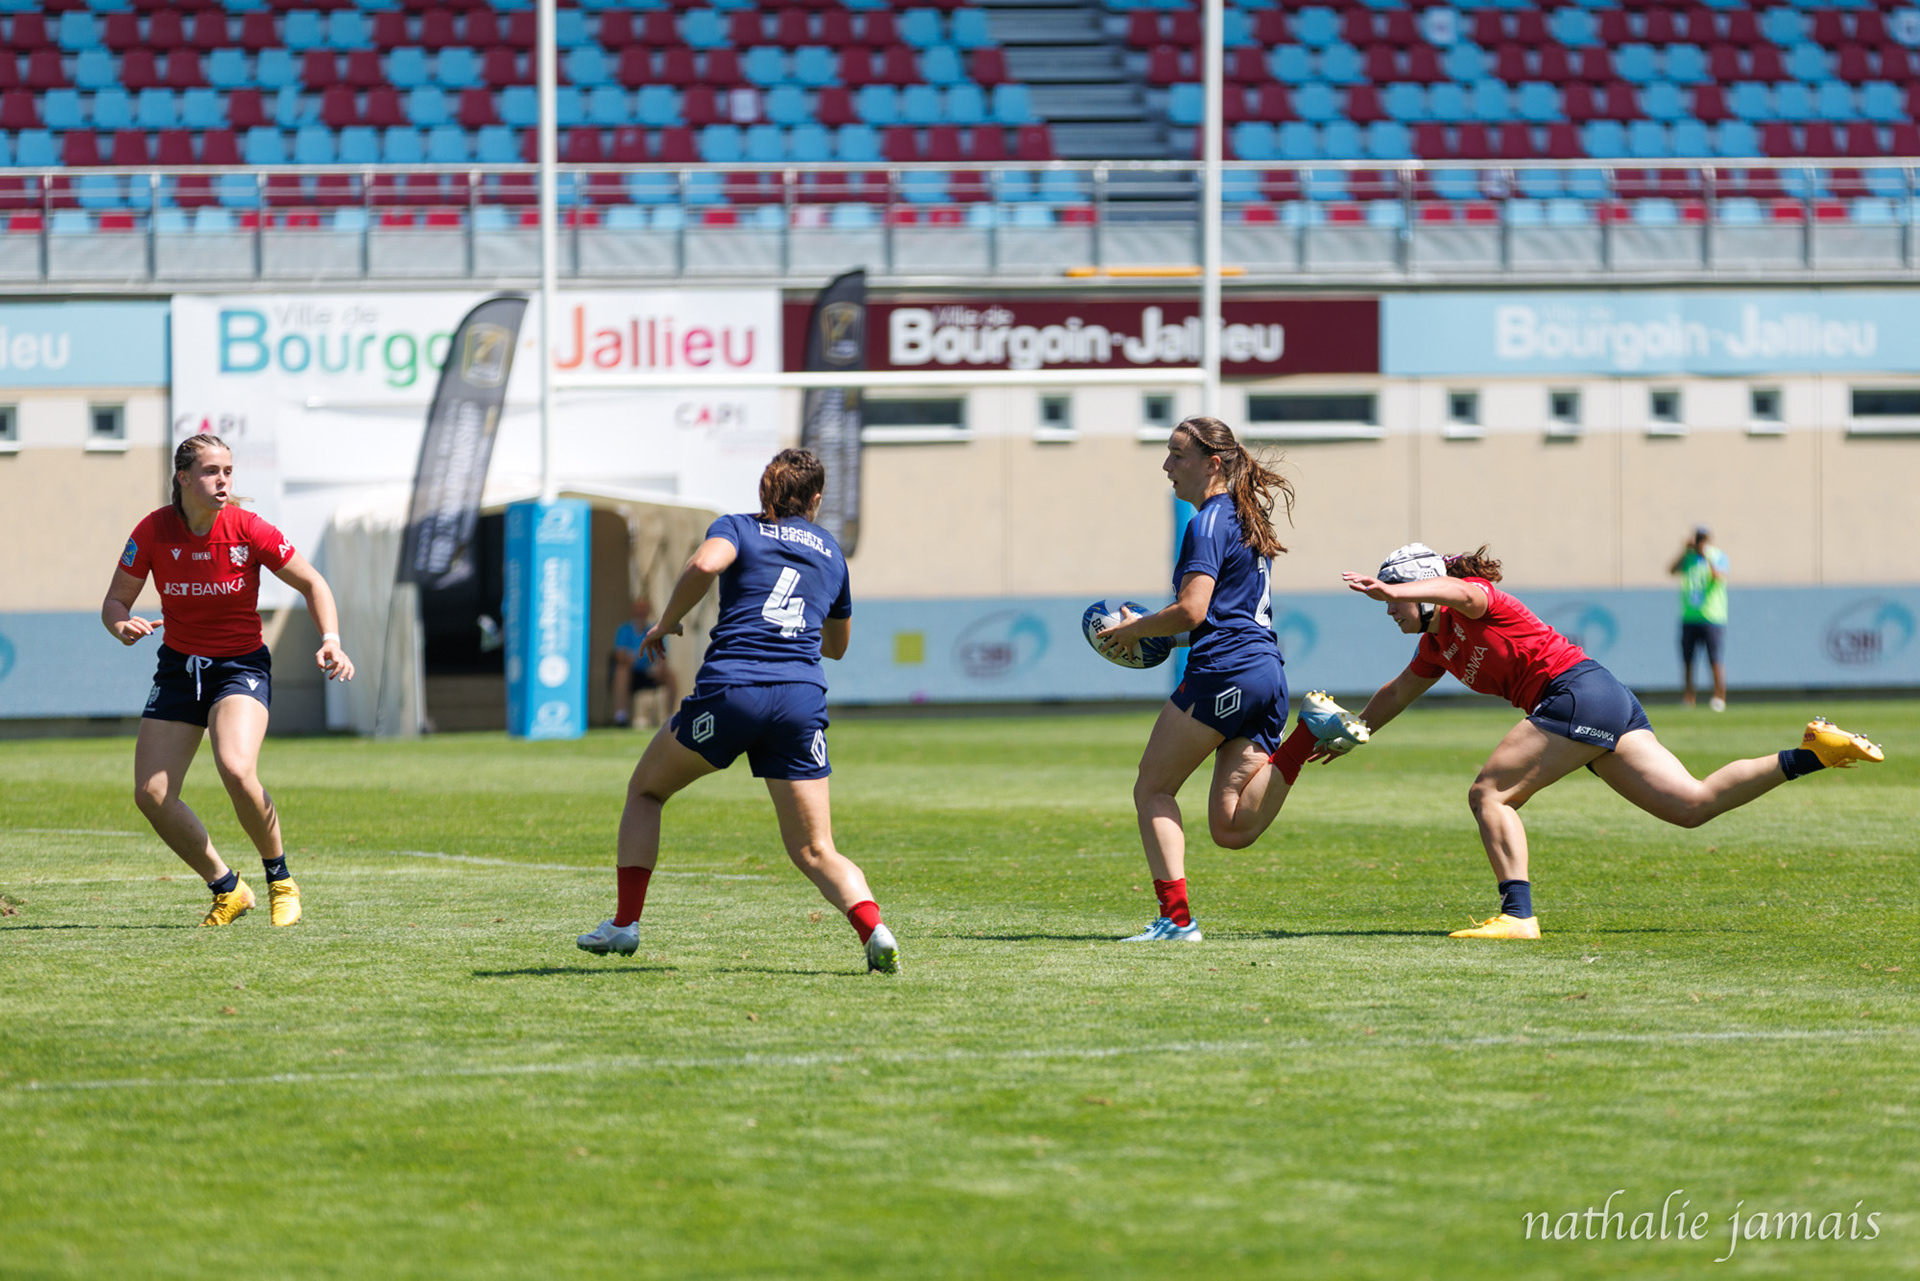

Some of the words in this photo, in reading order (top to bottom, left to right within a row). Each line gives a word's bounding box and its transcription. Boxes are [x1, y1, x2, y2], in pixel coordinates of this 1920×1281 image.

[163, 582, 190, 596] J&T
[191, 577, 246, 596] BANKA
[761, 566, 806, 638] 4
[1465, 645, 1488, 685] BANKA
[1590, 729, 1615, 742] BANKA
